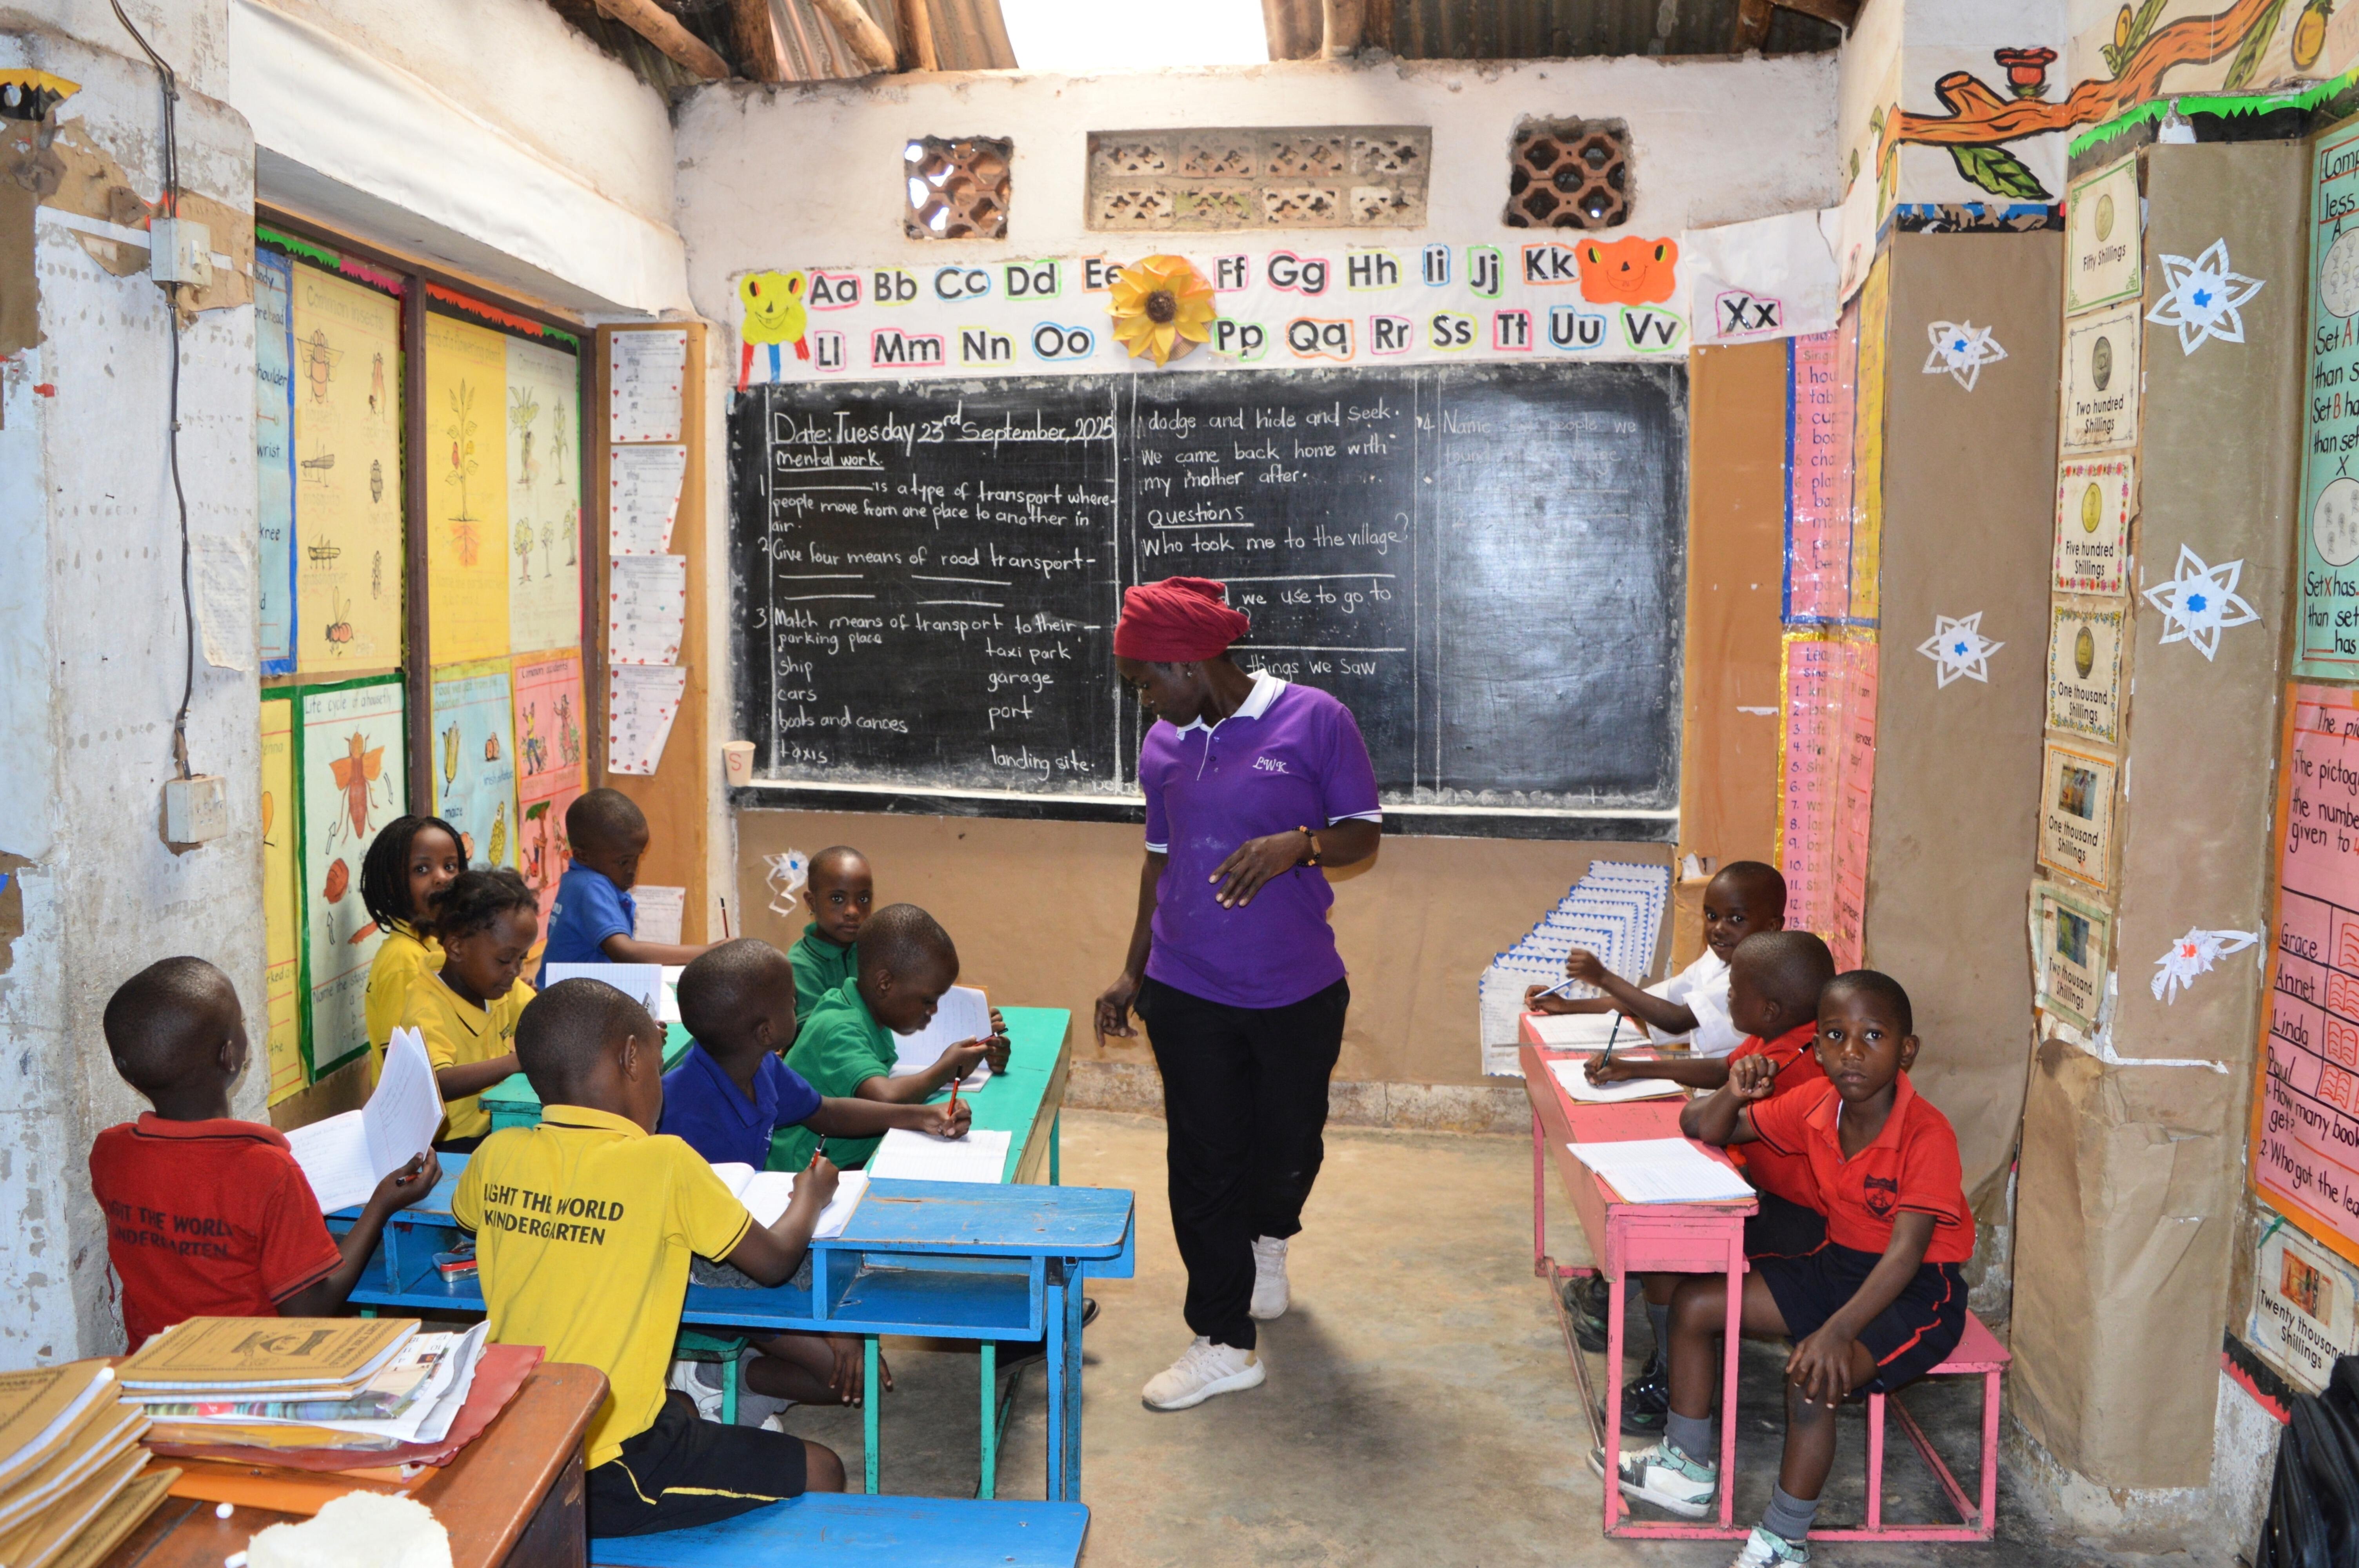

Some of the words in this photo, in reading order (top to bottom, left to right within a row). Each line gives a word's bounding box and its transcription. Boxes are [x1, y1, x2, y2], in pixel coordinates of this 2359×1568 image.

[2326, 193, 2355, 220] less
[2084, 254, 2096, 271] Fifty
[2098, 245, 2126, 266] Shillings
[810, 275, 858, 305] Aa
[876, 272, 917, 301] Bb
[935, 270, 987, 299] Cc
[1007, 265, 1055, 296] Dd
[1086, 258, 1124, 286] Ee
[1218, 256, 1245, 288] Ff
[1268, 255, 1325, 294] Gg
[1349, 253, 1398, 286] Hh
[1427, 249, 1444, 282] Ii
[1470, 254, 1498, 294] Jj
[1525, 247, 1575, 281] Kk
[307, 285, 347, 318] Common
[874, 332, 940, 363] Mm
[963, 331, 1011, 361] Nn
[1034, 326, 1089, 357] Oo
[1218, 320, 1263, 356] Pp
[1288, 320, 1347, 354] Qq
[1376, 319, 1409, 349] Rr
[1433, 315, 1471, 346] Ss
[1497, 314, 1527, 345] Tt
[1552, 312, 1599, 345] Uu
[1626, 314, 1677, 345] Vv
[1723, 297, 1779, 332] Xx
[2315, 326, 2339, 355] Set
[2315, 361, 2343, 389] than
[2077, 402, 2090, 416] Two
[2094, 394, 2123, 414] hundred
[2313, 397, 2331, 423] Set
[2333, 393, 2341, 419] B
[834, 412, 914, 456] Tuesday
[1074, 416, 1114, 441] 2025
[1149, 410, 1196, 439] dodge
[1209, 408, 1243, 430] and
[1257, 407, 1295, 429] hide
[1307, 402, 1339, 426] and
[1443, 408, 1490, 434] Name
[1549, 413, 1598, 443] people
[1615, 420, 1637, 434] we
[2085, 418, 2114, 434] Shillings
[257, 444, 280, 458] wrist
[1141, 450, 1162, 466] We
[1176, 450, 1219, 463] came
[1235, 438, 1279, 460] back
[1295, 439, 1336, 458] home
[1348, 432, 1386, 455] with
[2314, 430, 2336, 454] than
[912, 473, 944, 504] type
[954, 483, 969, 497] of
[980, 481, 1062, 513] transport
[1144, 478, 1170, 497] my
[1185, 467, 1243, 488] mother
[774, 497, 813, 518] people
[821, 499, 858, 514] move
[864, 498, 897, 517] from
[903, 505, 926, 518] one
[933, 501, 969, 529] place
[976, 505, 989, 521] to
[996, 505, 1066, 526] another
[1076, 510, 1089, 526] in
[1148, 502, 1243, 526] Questions
[260, 524, 280, 541] knee
[1143, 531, 1182, 556] Who
[1191, 532, 1234, 552] took
[1247, 537, 1275, 550] me
[1285, 527, 1305, 549] to
[1313, 524, 1344, 547] the
[773, 546, 802, 563] Give
[810, 541, 839, 565] four
[848, 553, 901, 565] means
[910, 548, 927, 564] of
[942, 549, 979, 565] road
[2066, 541, 2079, 555] Five
[2082, 541, 2114, 557] hundred
[2075, 560, 2105, 579] Shillings
[2305, 571, 2324, 596] Set
[2333, 570, 2356, 597] has
[1242, 595, 1267, 604] we
[1281, 589, 1311, 604] use
[1316, 584, 1336, 604] to
[1345, 593, 1363, 613] go
[1370, 579, 1391, 600] to
[775, 607, 818, 627] Match
[829, 615, 882, 628] means
[890, 614, 910, 628] of
[916, 613, 1004, 640] transport
[1015, 615, 1031, 633] to
[1034, 614, 1076, 632] their
[2308, 603, 2328, 627] than
[2335, 606, 2359, 627] set
[778, 633, 838, 655] parking
[849, 632, 882, 653] place
[986, 638, 1022, 658] taxi
[1030, 642, 1070, 664] park
[2335, 629, 2356, 654] has
[778, 659, 812, 681] ship
[989, 672, 1053, 693] garage
[1246, 654, 1299, 682] things
[1309, 661, 1331, 673] we
[305, 696, 322, 714] Life
[778, 688, 817, 701] cars
[2058, 682, 2072, 697] One
[2074, 685, 2107, 705] thousand
[779, 706, 814, 732] boats
[821, 707, 851, 726] and
[856, 717, 907, 733] canoes
[989, 696, 1032, 730] port
[2069, 702, 2097, 724] Shillings
[2317, 707, 2335, 733] The
[780, 741, 828, 763] taxis
[992, 745, 1050, 780] landing
[2294, 750, 2312, 777] The
[2293, 787, 2310, 818] the
[2049, 816, 2062, 832] One
[2064, 821, 2098, 847] thousand
[2289, 820, 2327, 853] given
[2337, 828, 2350, 853] to
[2058, 838, 2085, 863] Shillings
[2281, 923, 2318, 959] Grace
[2049, 957, 2061, 972] Two
[2062, 965, 2092, 996] thousand
[2275, 964, 2315, 1001] Annet
[2057, 981, 2084, 1011] Shillings
[2272, 1009, 2308, 1047] Linda
[2267, 1045, 2296, 1083] Paul
[2273, 1080, 2293, 1112] How
[2296, 1103, 2330, 1141] many
[2271, 1139, 2294, 1174] Who
[2293, 1165, 2313, 1189] got
[2318, 1171, 2338, 1203] the
[523, 1190, 552, 1214] THE
[556, 1198, 623, 1222] WORLD
[484, 1209, 605, 1246] KINDERGARTEN
[2261, 1290, 2295, 1328] Twenty
[2281, 1328, 2322, 1370] Shillings
